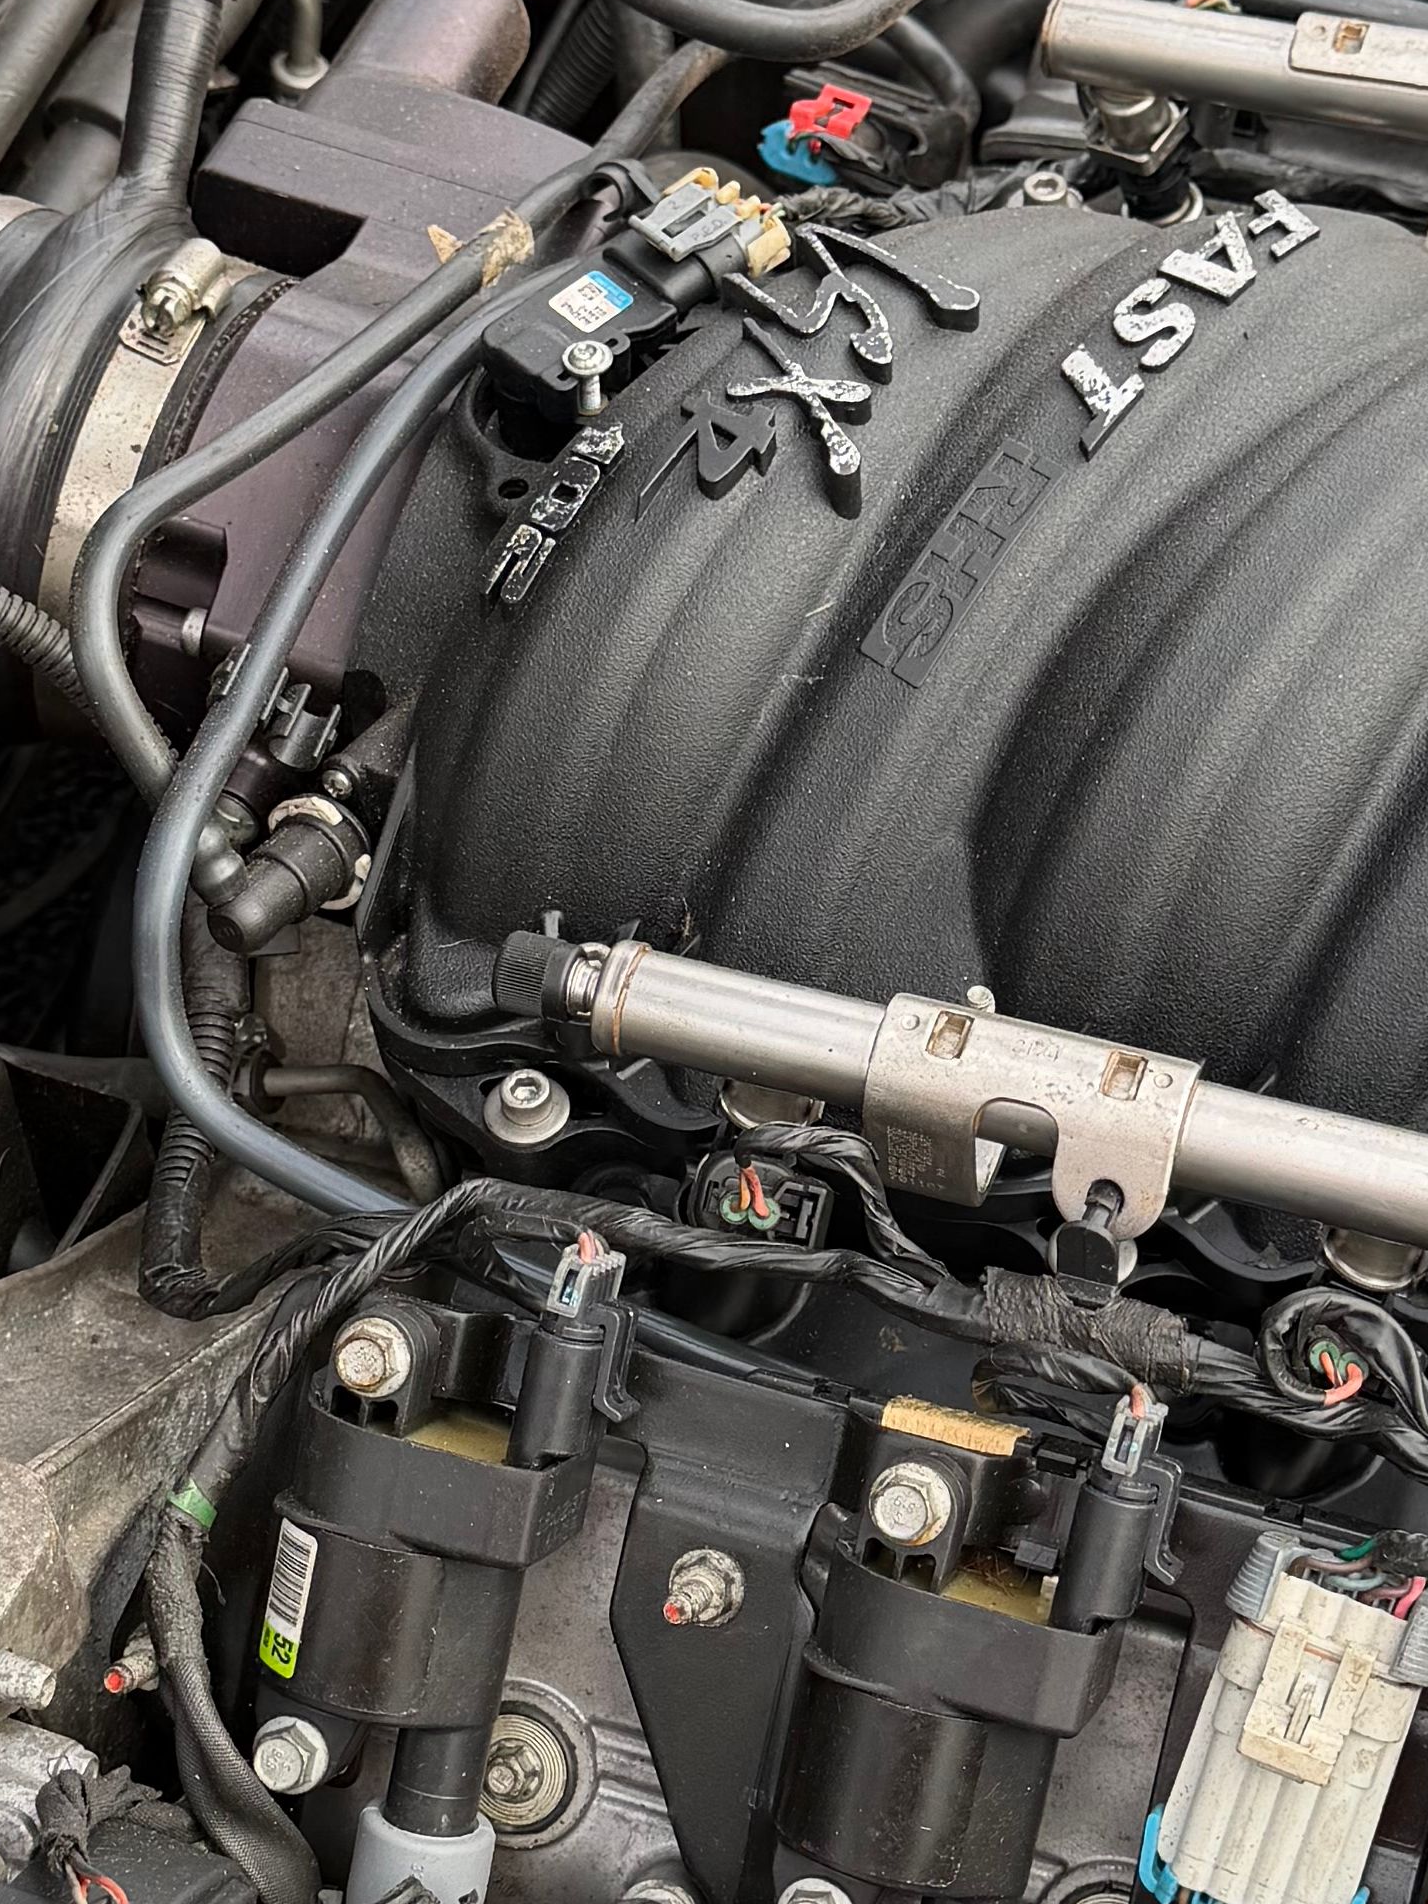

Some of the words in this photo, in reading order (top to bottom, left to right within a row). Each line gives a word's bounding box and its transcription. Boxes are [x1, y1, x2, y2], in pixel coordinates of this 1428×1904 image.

[1062, 190, 1320, 460] FAST
[485, 421, 624, 603] 102
[870, 446, 1060, 676] RHS
[273, 1633, 294, 1667] 52
